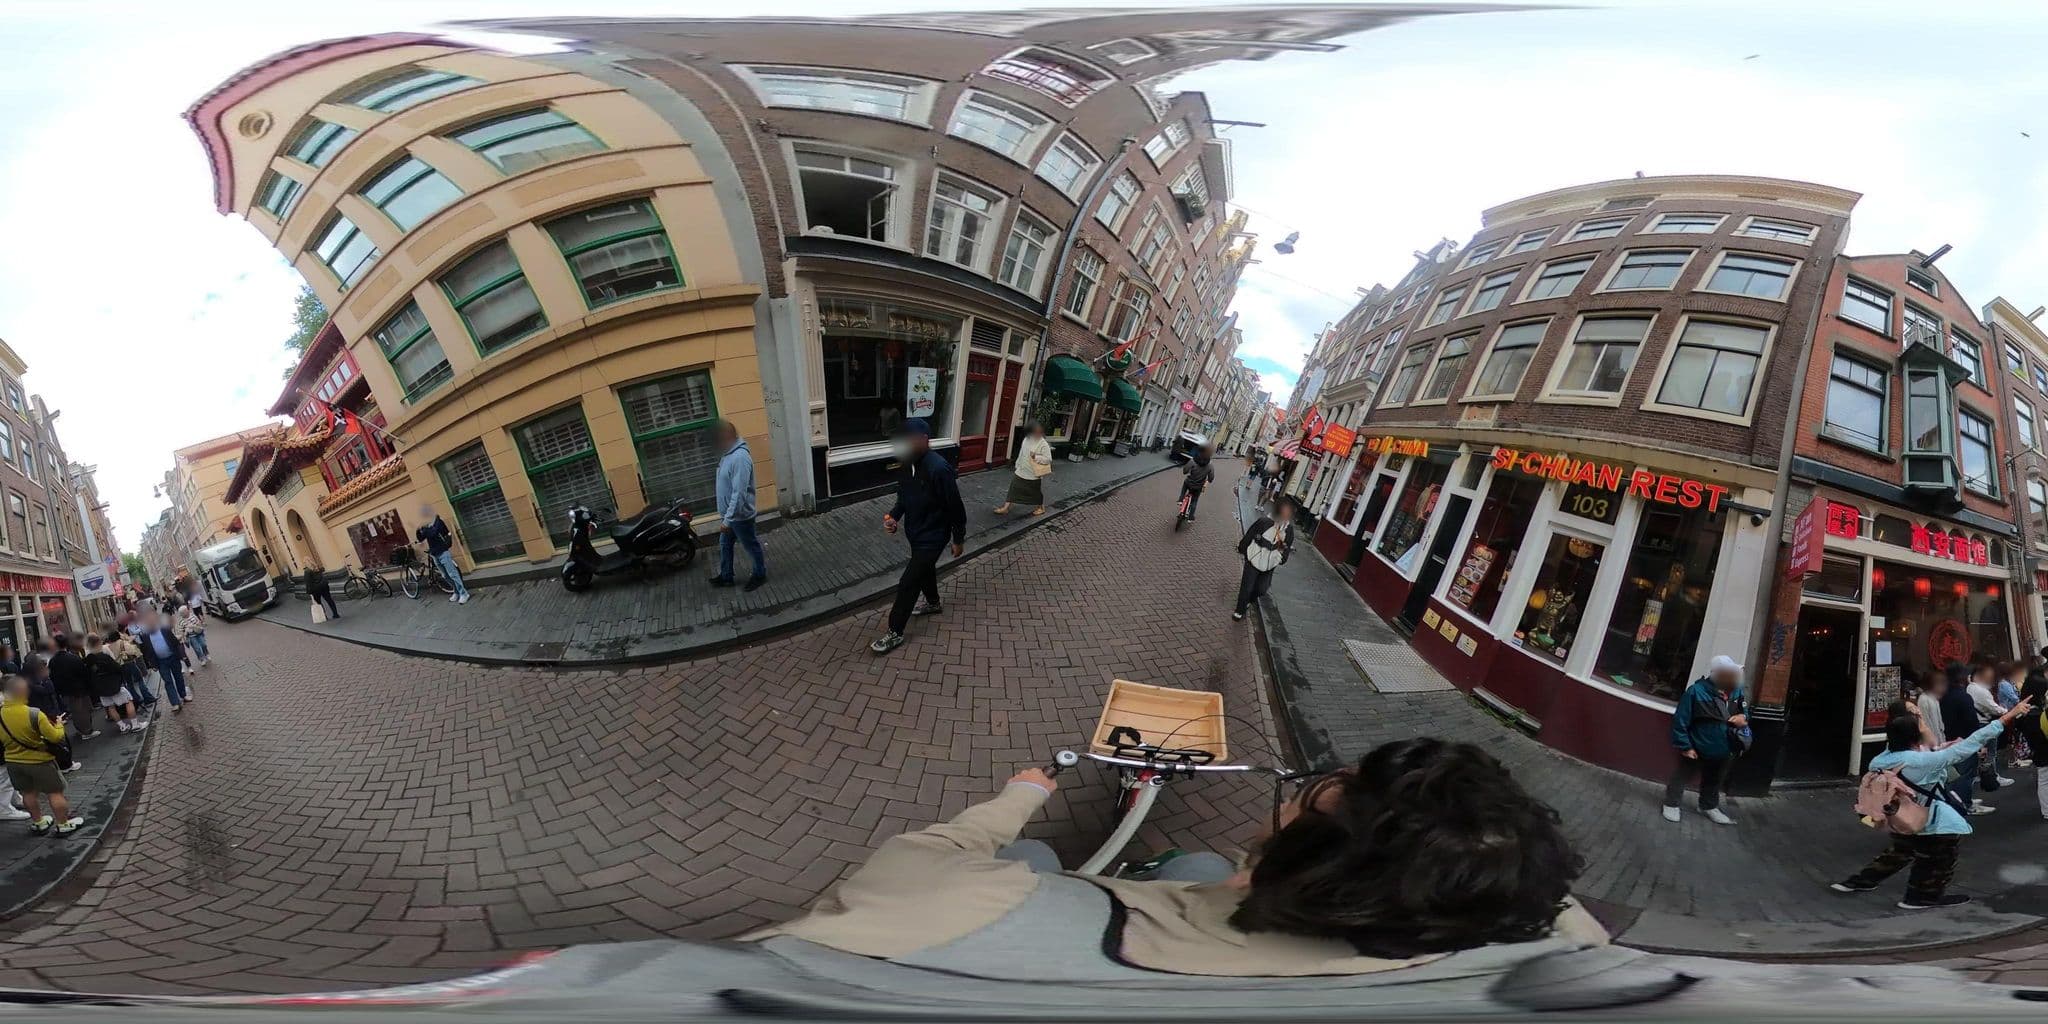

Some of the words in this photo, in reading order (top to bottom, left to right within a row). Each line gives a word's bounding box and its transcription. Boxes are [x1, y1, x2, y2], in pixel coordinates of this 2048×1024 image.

[1392, 438, 1429, 458] CHINA
[1492, 447, 1622, 492] SI-CHUAN
[1629, 470, 1728, 513] REST
[1572, 494, 1608, 518] 103
